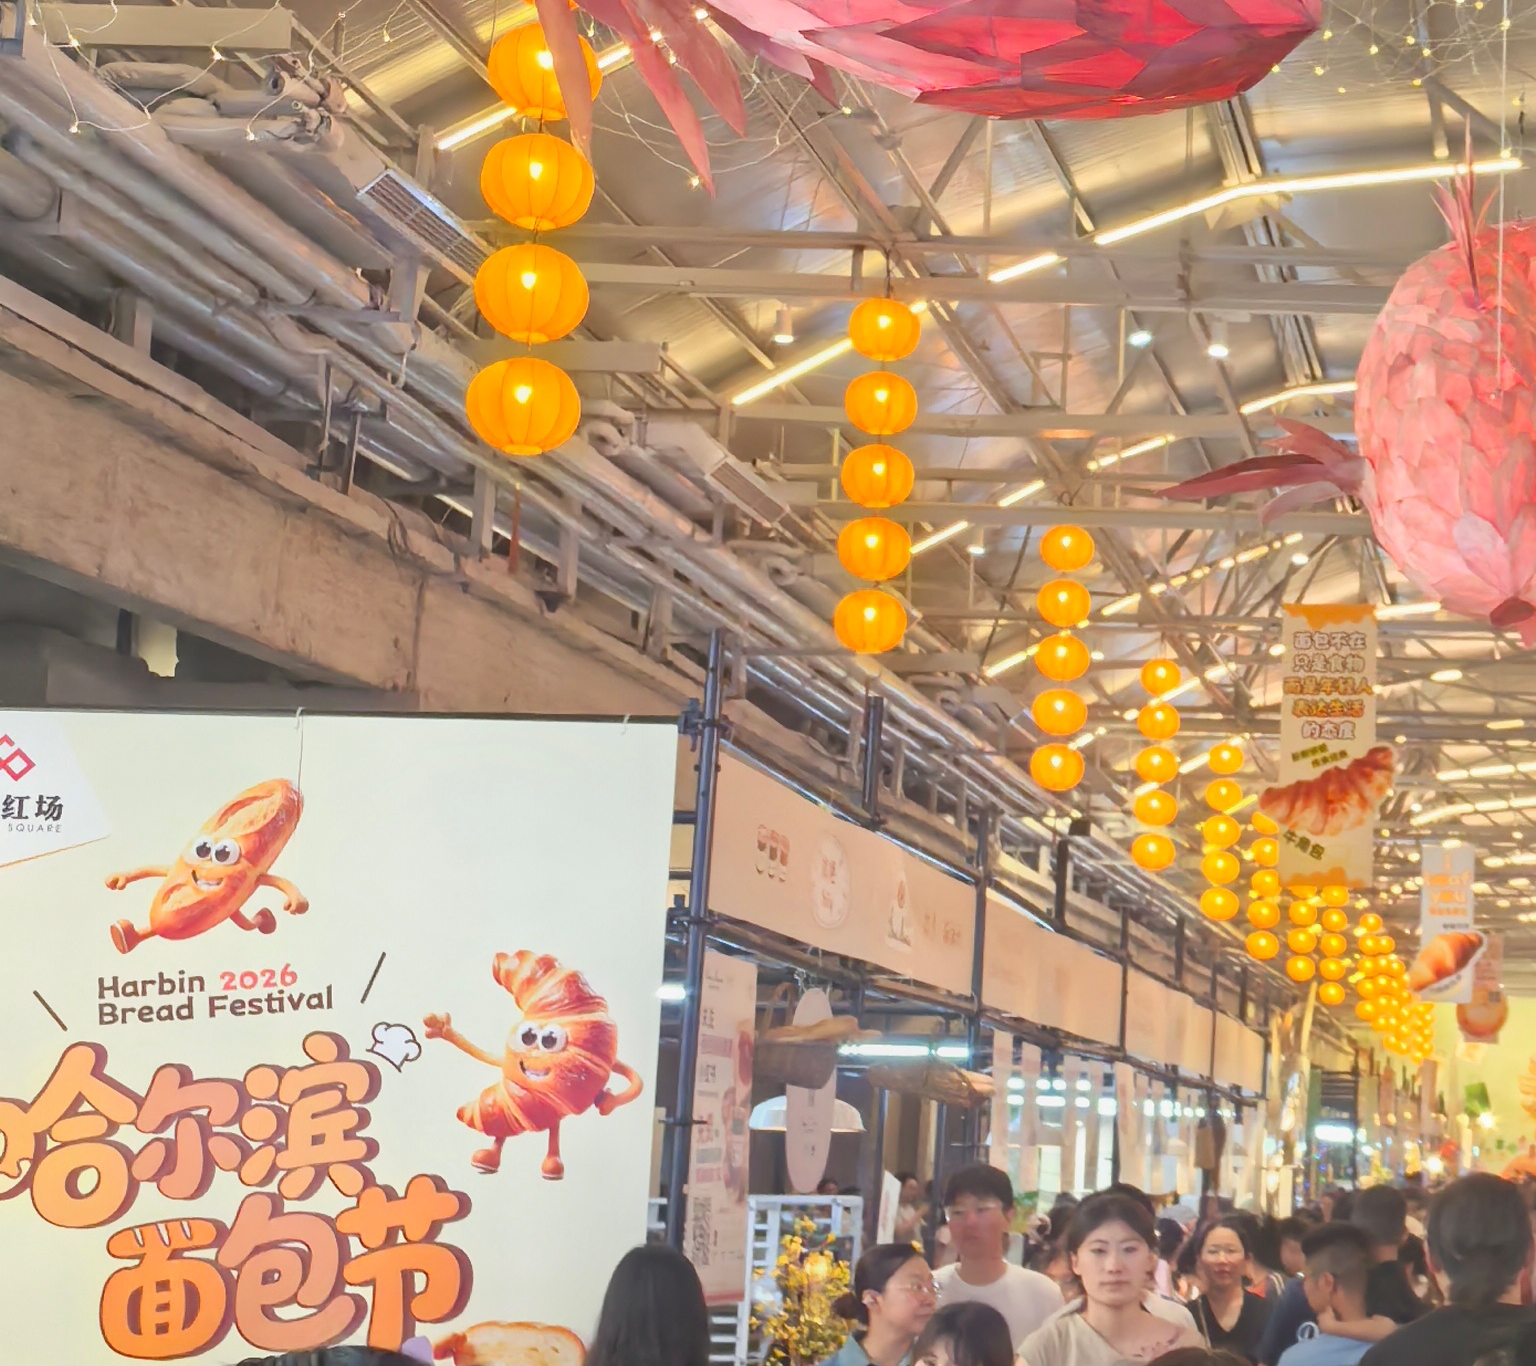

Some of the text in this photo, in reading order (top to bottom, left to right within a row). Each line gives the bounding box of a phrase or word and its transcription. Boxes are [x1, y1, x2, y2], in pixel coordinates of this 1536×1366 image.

[1, 794, 63, 821] 红场
[98, 963, 298, 999] Harbin 2026
[98, 984, 334, 1025] Bread Festival
[0, 1031, 382, 1229] 哈尔滨
[100, 1173, 473, 1361] 面包节
